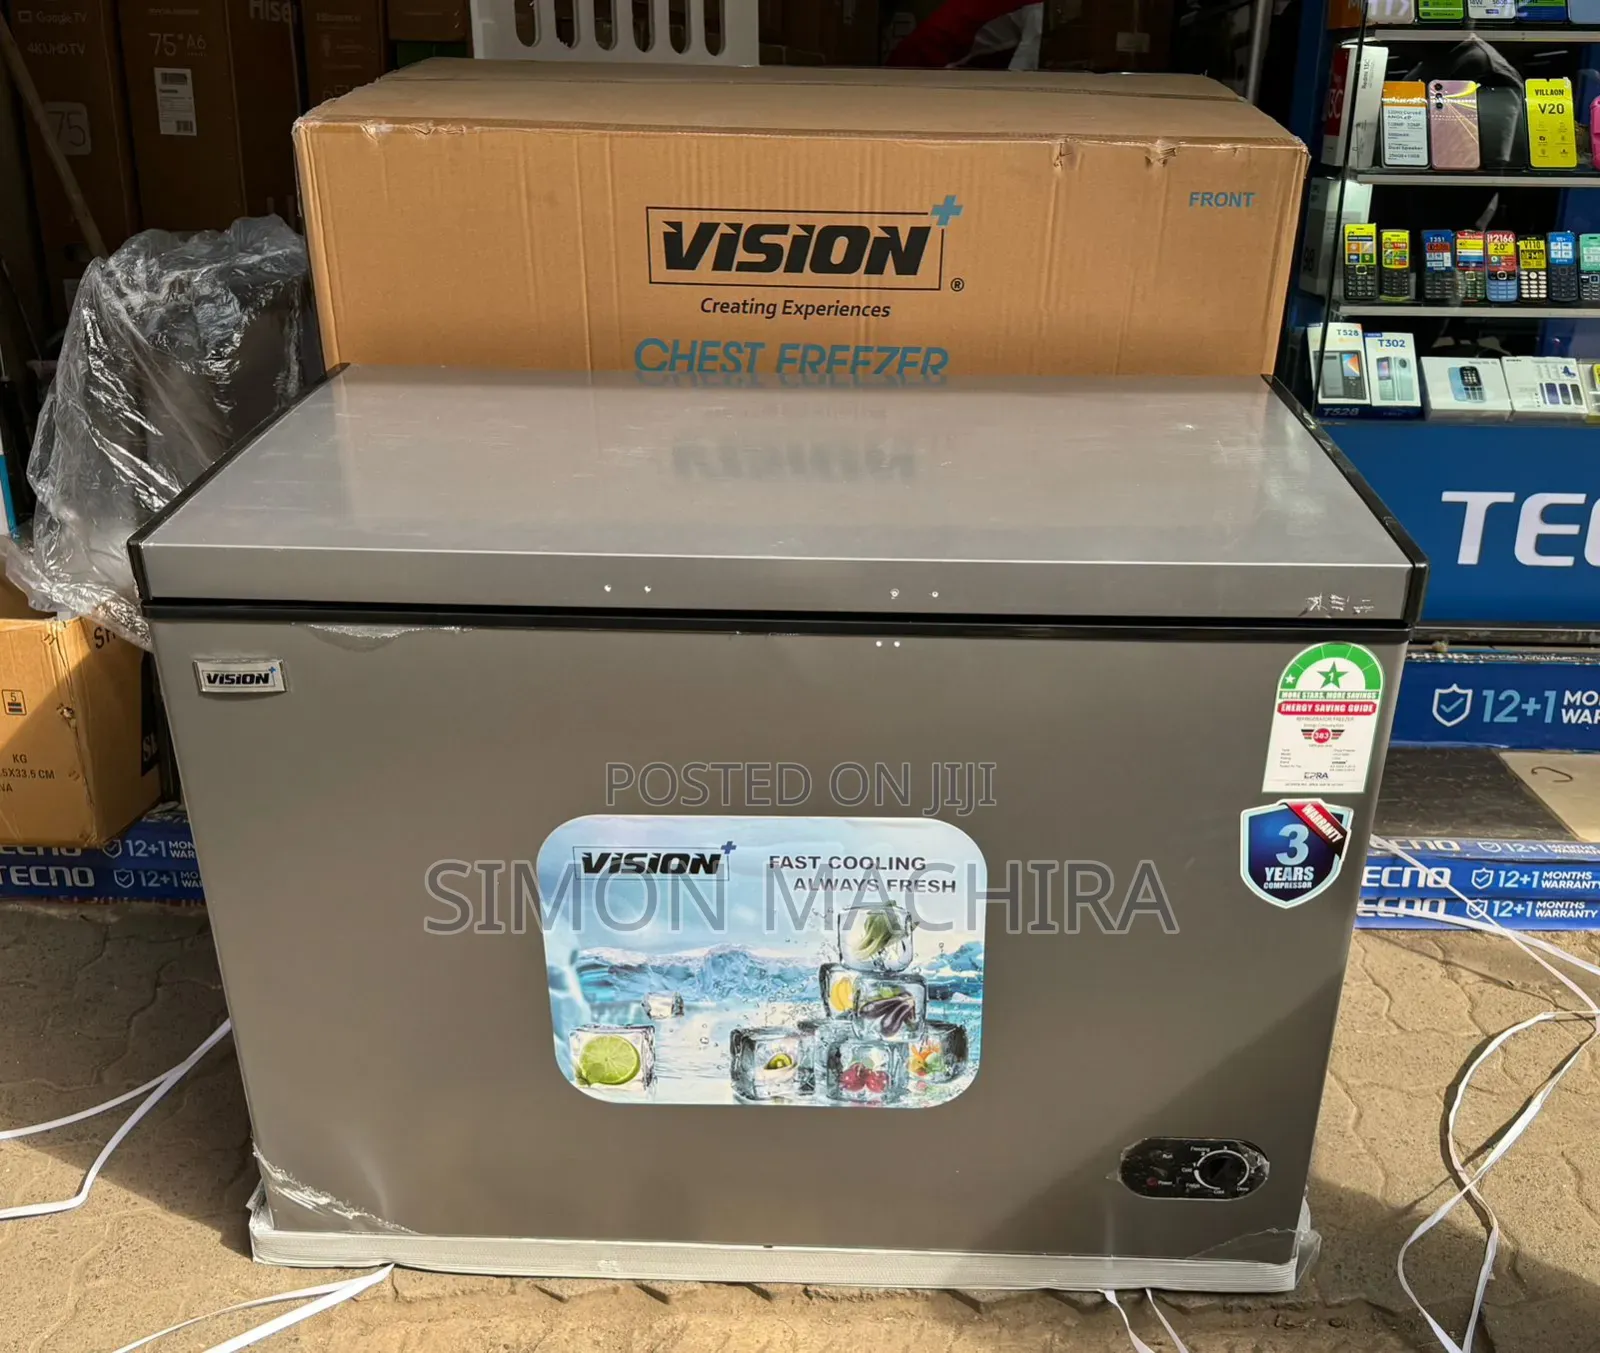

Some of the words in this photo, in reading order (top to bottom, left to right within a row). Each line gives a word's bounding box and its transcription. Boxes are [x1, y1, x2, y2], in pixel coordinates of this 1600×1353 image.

[72, 11, 89, 22] TV
[1538, 103, 1565, 115] V20
[47, 110, 86, 147] 75
[1189, 191, 1258, 208] FRONT
[701, 298, 777, 319] Creating
[782, 300, 891, 319] Experiences
[1377, 339, 1406, 348] T302
[634, 337, 766, 374] CHEST
[776, 343, 949, 375] FREEZER
[1441, 491, 1600, 567] TE
[1281, 691, 1300, 699] MORE
[1326, 691, 1346, 699] MORE
[1563, 690, 1600, 706] MO
[1280, 703, 1313, 712] ENERGY
[1314, 703, 1347, 712] SAVING
[1347, 703, 1374, 712] GUIDE
[1482, 689, 1557, 724] 12+1
[12, 754, 28, 763] KG
[38, 769, 55, 779] CM
[1301, 803, 1343, 843] WARRANTY
[125, 840, 167, 858] 12+1
[1275, 823, 1309, 866] 3
[769, 855, 822, 870] FAST
[828, 856, 927, 871] COOLING
[138, 870, 179, 888] 12+1
[1264, 866, 1314, 882] YEARS
[1498, 870, 1540, 888] 12+1
[1542, 871, 1593, 880] MONTHS
[181, 880, 203, 888] WA
[794, 878, 880, 893] ALWAYS
[887, 879, 956, 893] FRESH
[1492, 900, 1533, 917] 12+1
[1536, 901, 1586, 909] MONTHS
[1535, 909, 1598, 918] WARRANTY
